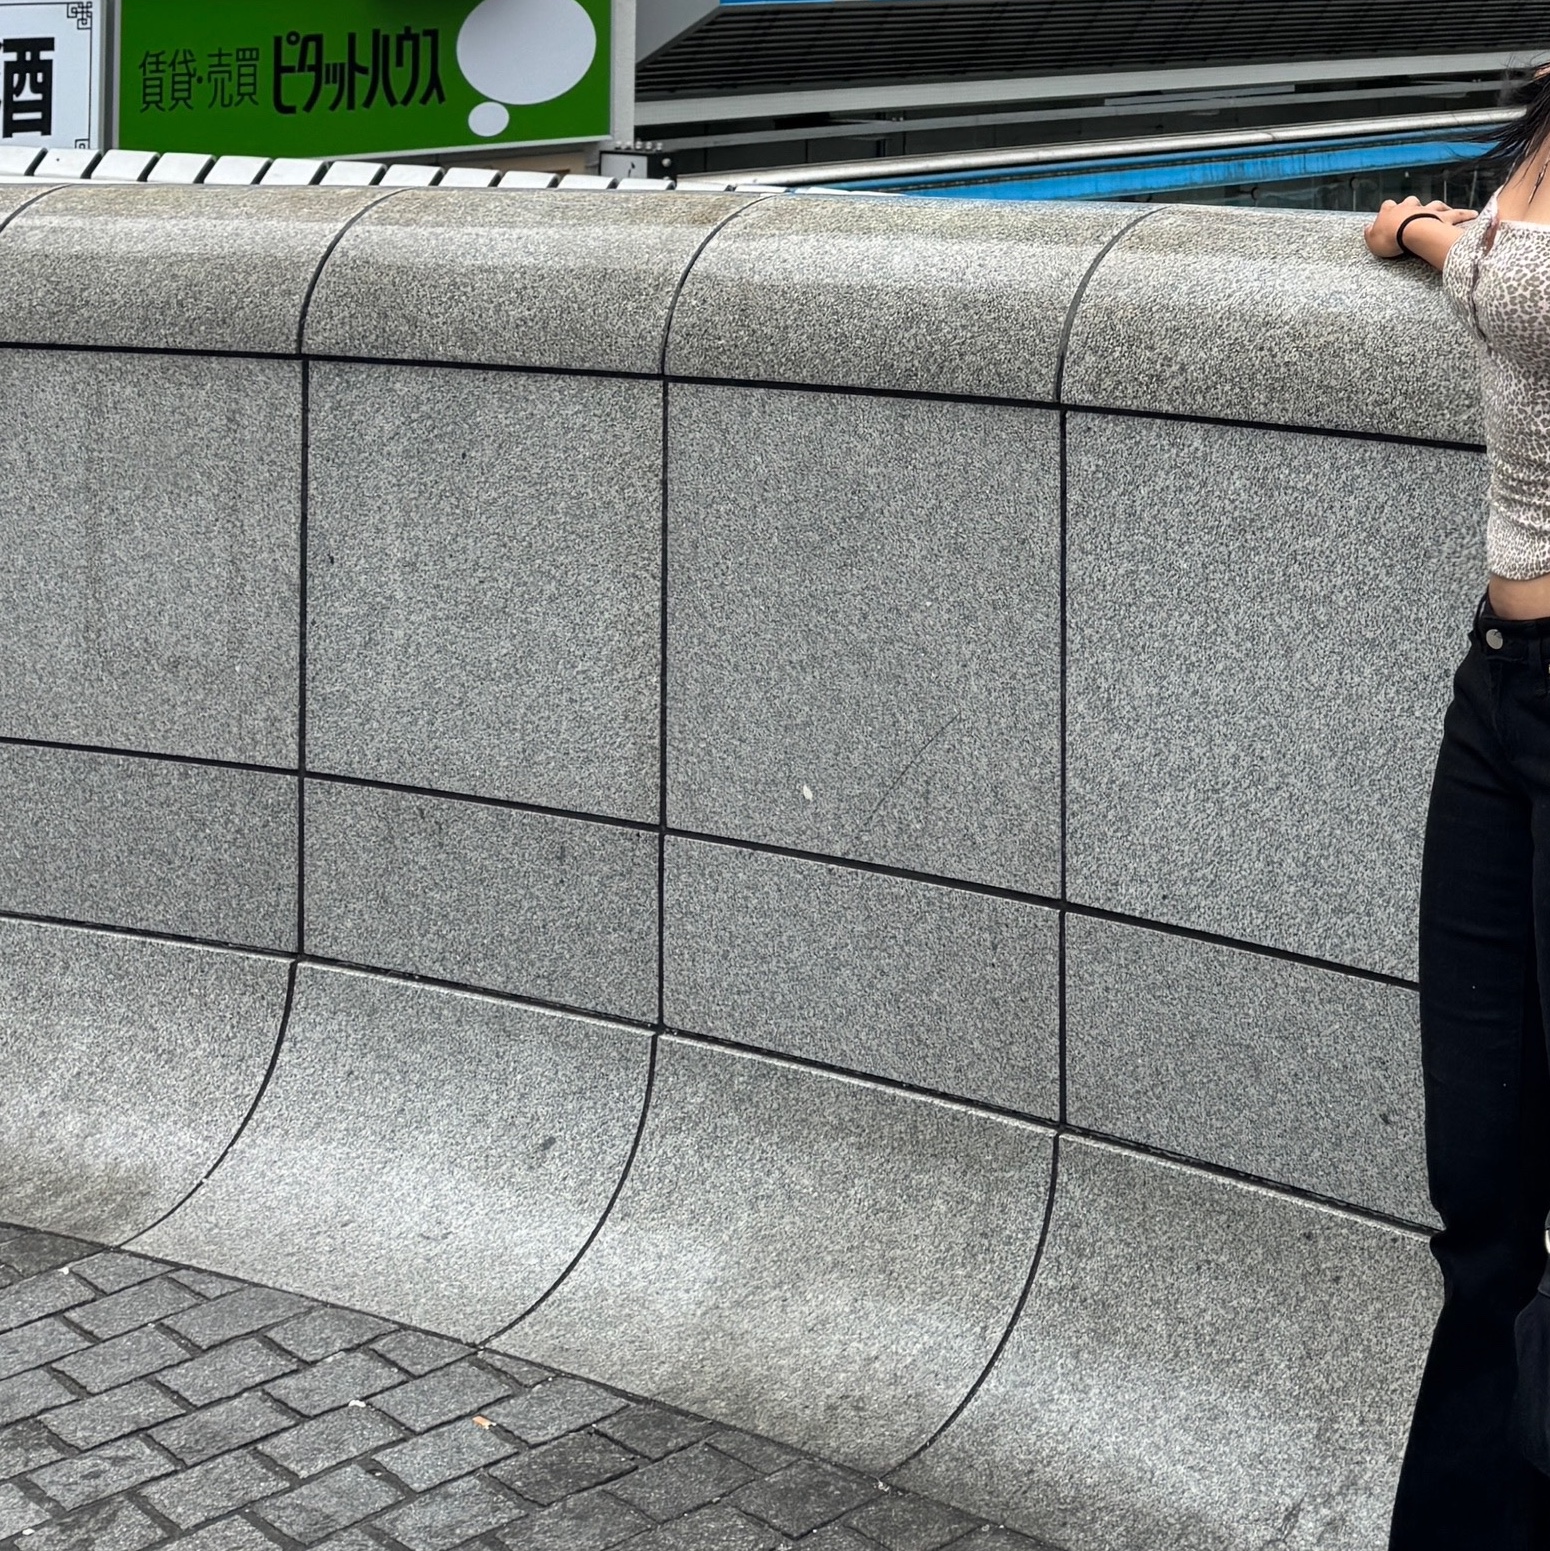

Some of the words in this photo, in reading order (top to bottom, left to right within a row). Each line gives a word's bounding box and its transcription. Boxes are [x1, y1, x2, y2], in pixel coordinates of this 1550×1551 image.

[138, 47, 260, 114] 賃貸・売買
[272, 25, 447, 115] ピタットハウス
